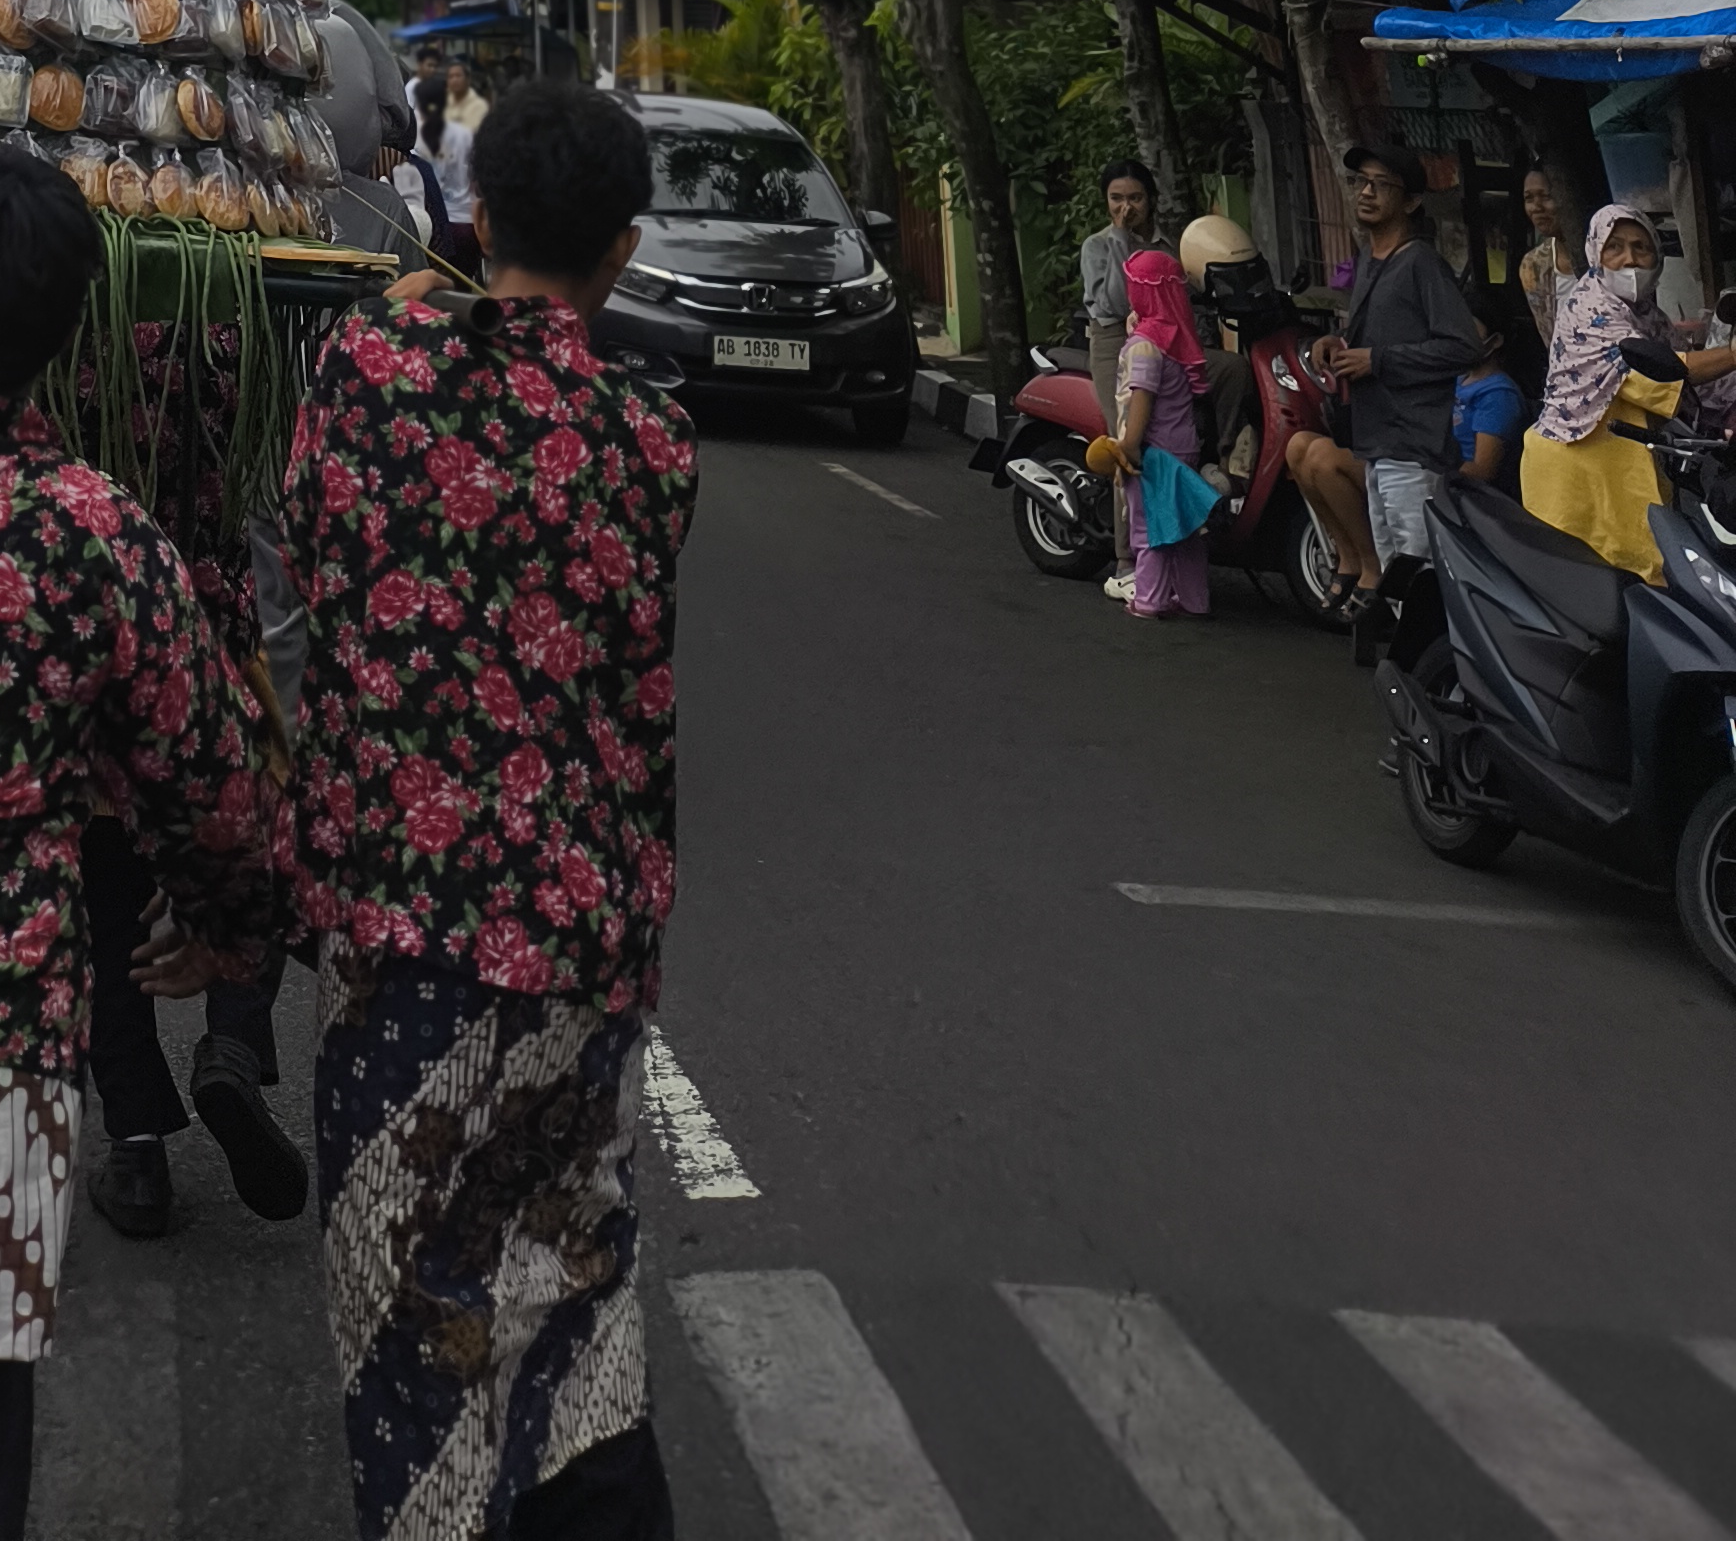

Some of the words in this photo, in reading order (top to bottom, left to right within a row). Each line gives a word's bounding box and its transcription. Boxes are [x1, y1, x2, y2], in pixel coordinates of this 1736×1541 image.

[717, 338, 735, 356] AB
[743, 340, 780, 359] 1838
[788, 343, 807, 360] TY
